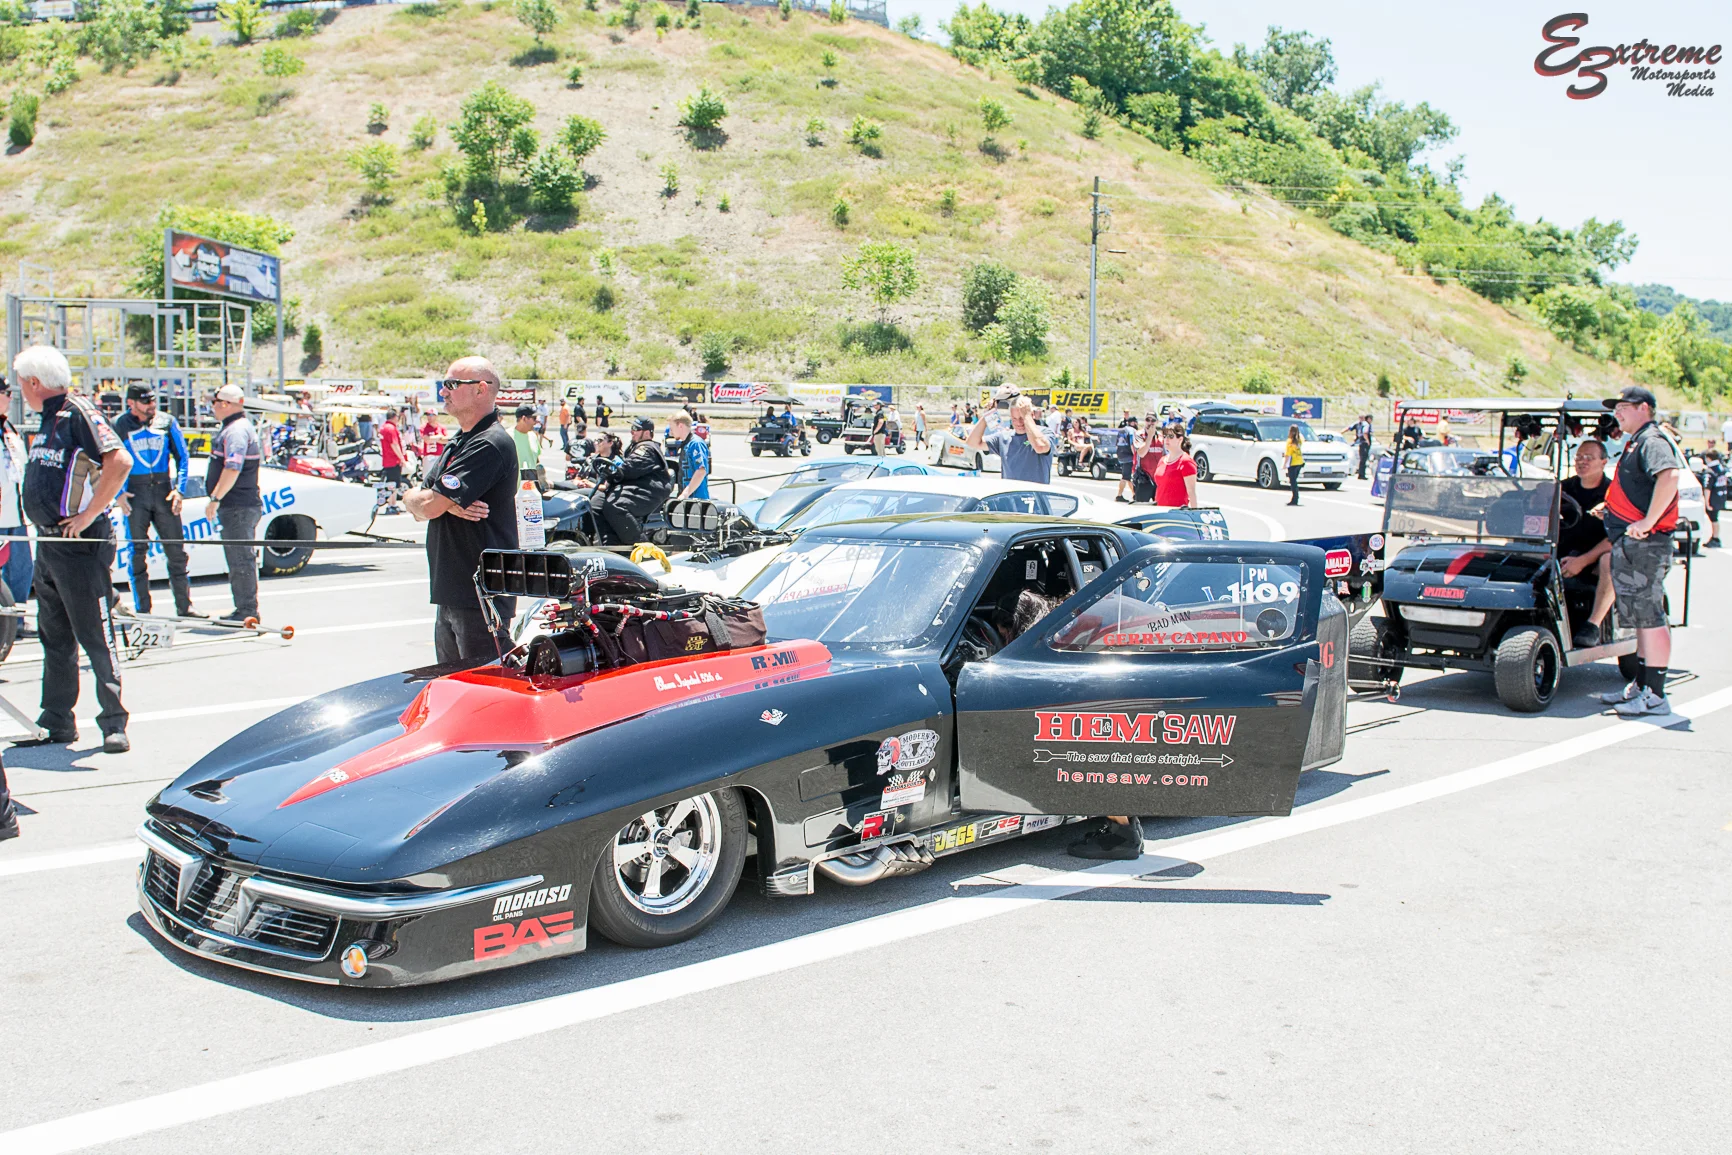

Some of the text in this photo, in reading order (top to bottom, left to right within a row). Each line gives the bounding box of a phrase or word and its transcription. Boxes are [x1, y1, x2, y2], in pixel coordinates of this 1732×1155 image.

[1055, 392, 1104, 406] JEGS
[1248, 568, 1268, 582] PM
[1227, 581, 1299, 604] 1109
[1103, 631, 1247, 646] GERRY CAPANO
[1163, 713, 1237, 745] SAW
[1066, 751, 1201, 766] The saw that cuts straight.
[1057, 768, 1209, 786] hemsaw.com
[935, 823, 975, 852] JEGS
[492, 883, 573, 915] MOROSO
[505, 910, 523, 919] PANS
